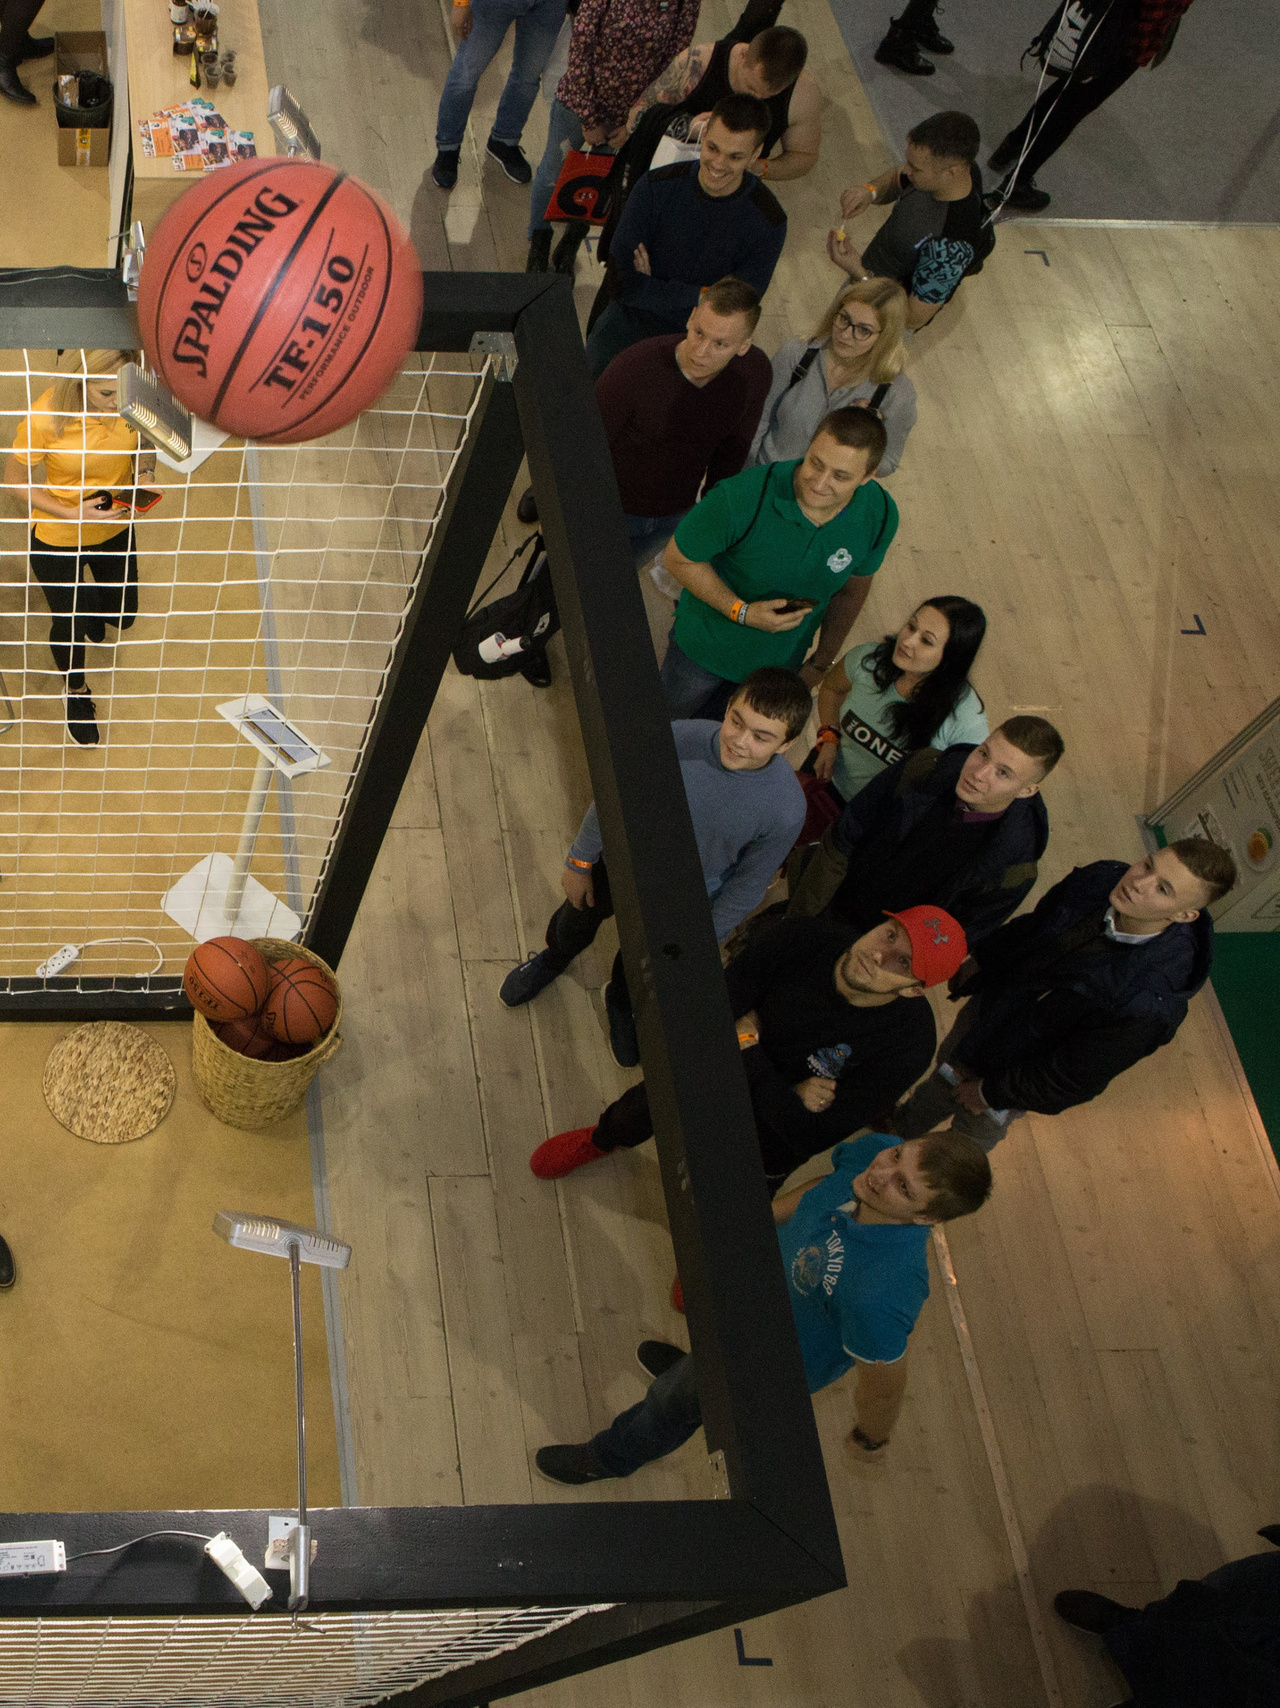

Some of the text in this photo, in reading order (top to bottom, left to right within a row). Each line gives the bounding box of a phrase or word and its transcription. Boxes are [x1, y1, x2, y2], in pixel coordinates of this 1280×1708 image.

[1044, 0, 1092, 71] NIKE
[172, 185, 301, 378] SPALDING
[265, 255, 355, 392] TF-150
[299, 265, 374, 400] PERFORMANCE OUTDOOR
[853, 726, 903, 765] ONE
